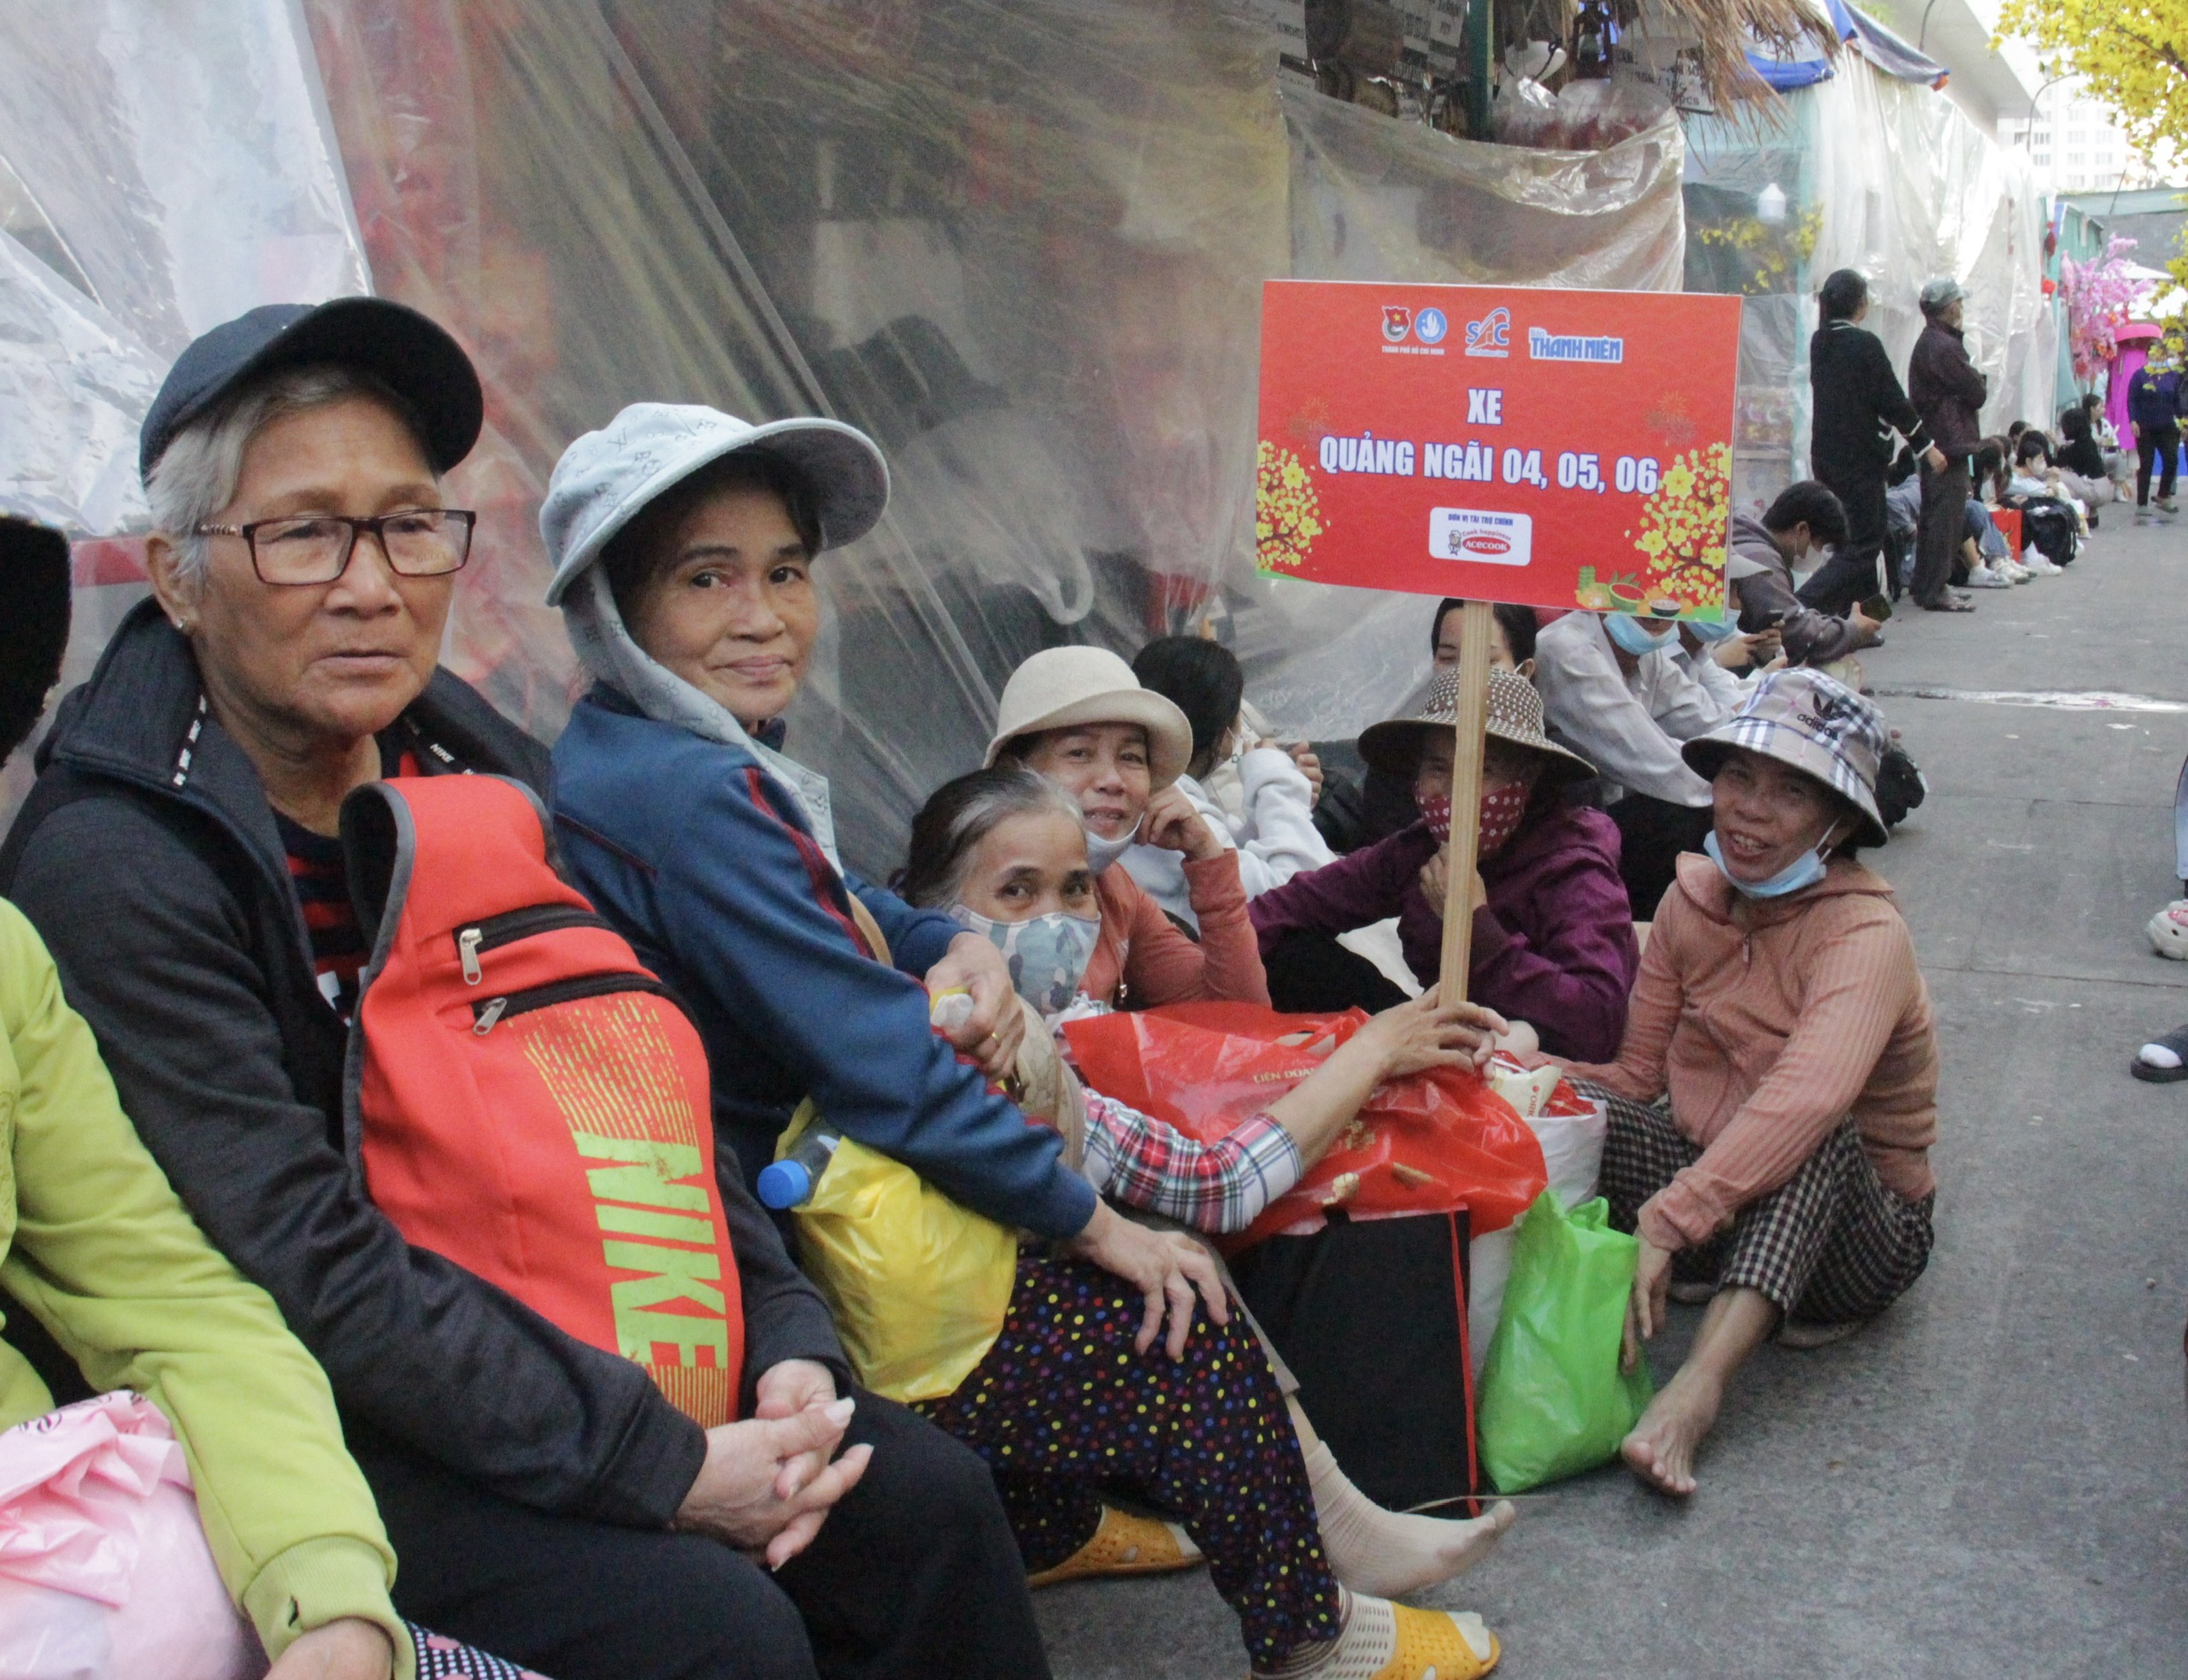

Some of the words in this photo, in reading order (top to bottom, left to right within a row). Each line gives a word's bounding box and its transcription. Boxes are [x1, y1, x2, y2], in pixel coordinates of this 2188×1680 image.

[1467, 388, 1503, 425] XE
[1319, 430, 1415, 475] QUẢNG
[1423, 440, 1494, 481] NGÃI
[1503, 448, 1549, 490] 04,
[1557, 451, 1606, 494] 05,
[1615, 455, 1660, 495] 06
[573, 1130, 729, 1369] NIKE
